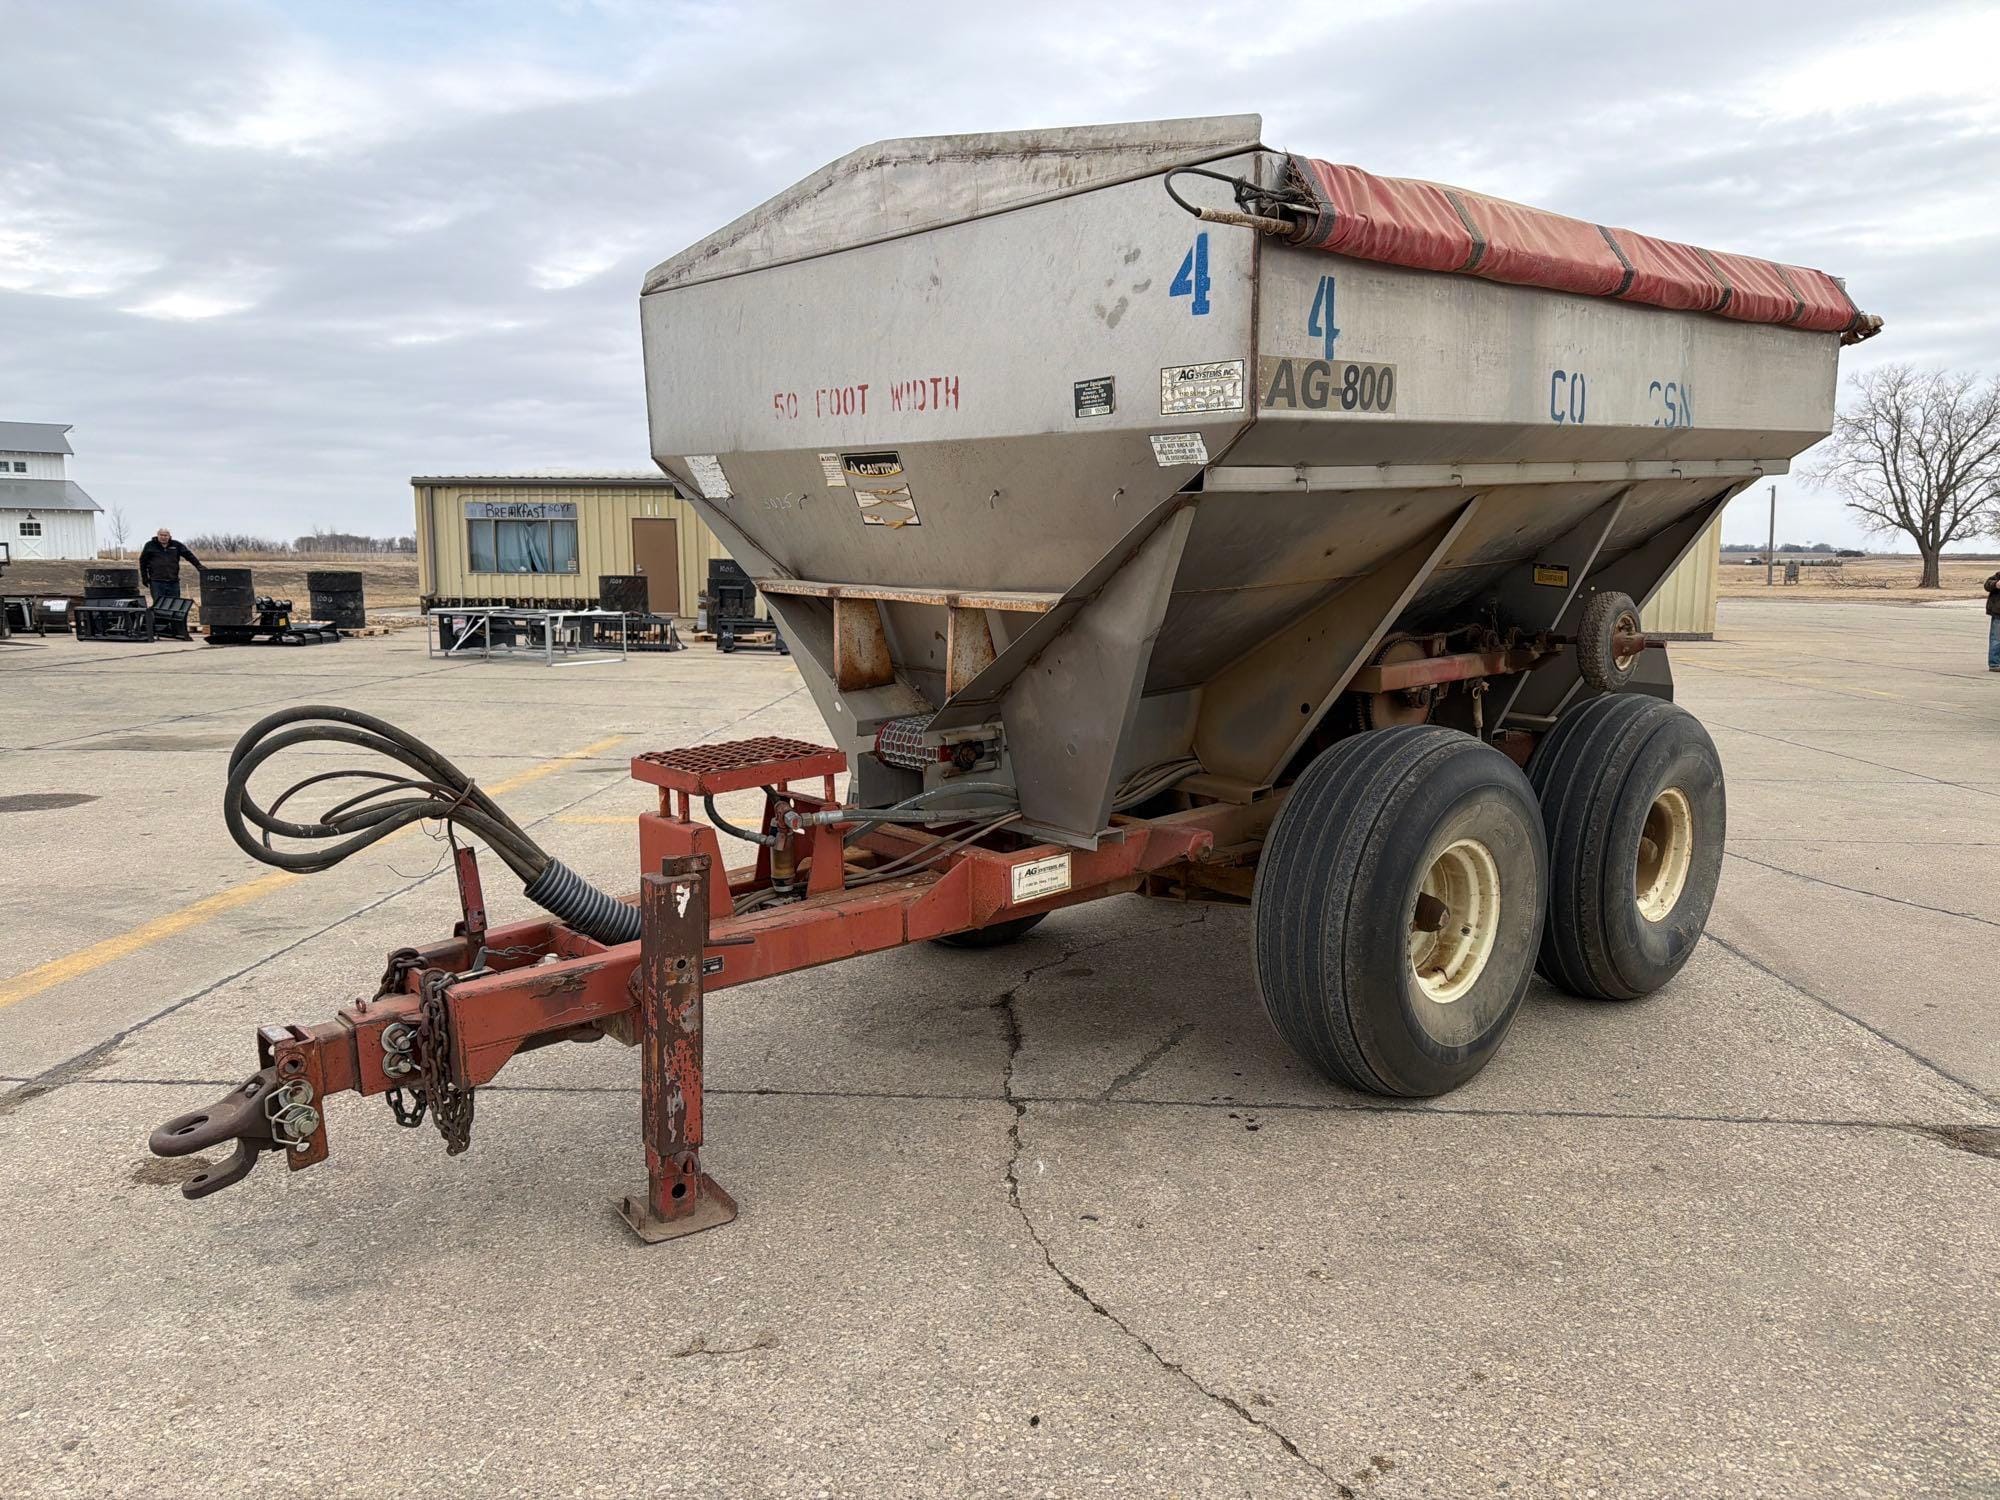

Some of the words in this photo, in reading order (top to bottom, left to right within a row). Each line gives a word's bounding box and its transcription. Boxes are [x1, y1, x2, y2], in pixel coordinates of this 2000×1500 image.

[1169, 232, 1210, 315] 4
[1308, 275, 1340, 361] 4
[1178, 369, 1195, 381] AG
[1195, 369, 1222, 380] SYSTEMS
[1264, 359, 1394, 411] AG-800
[773, 392, 798, 419] 50
[890, 376, 960, 412] WIDTH
[860, 462, 902, 475] CAUTION
[1025, 868, 1037, 877] AG
